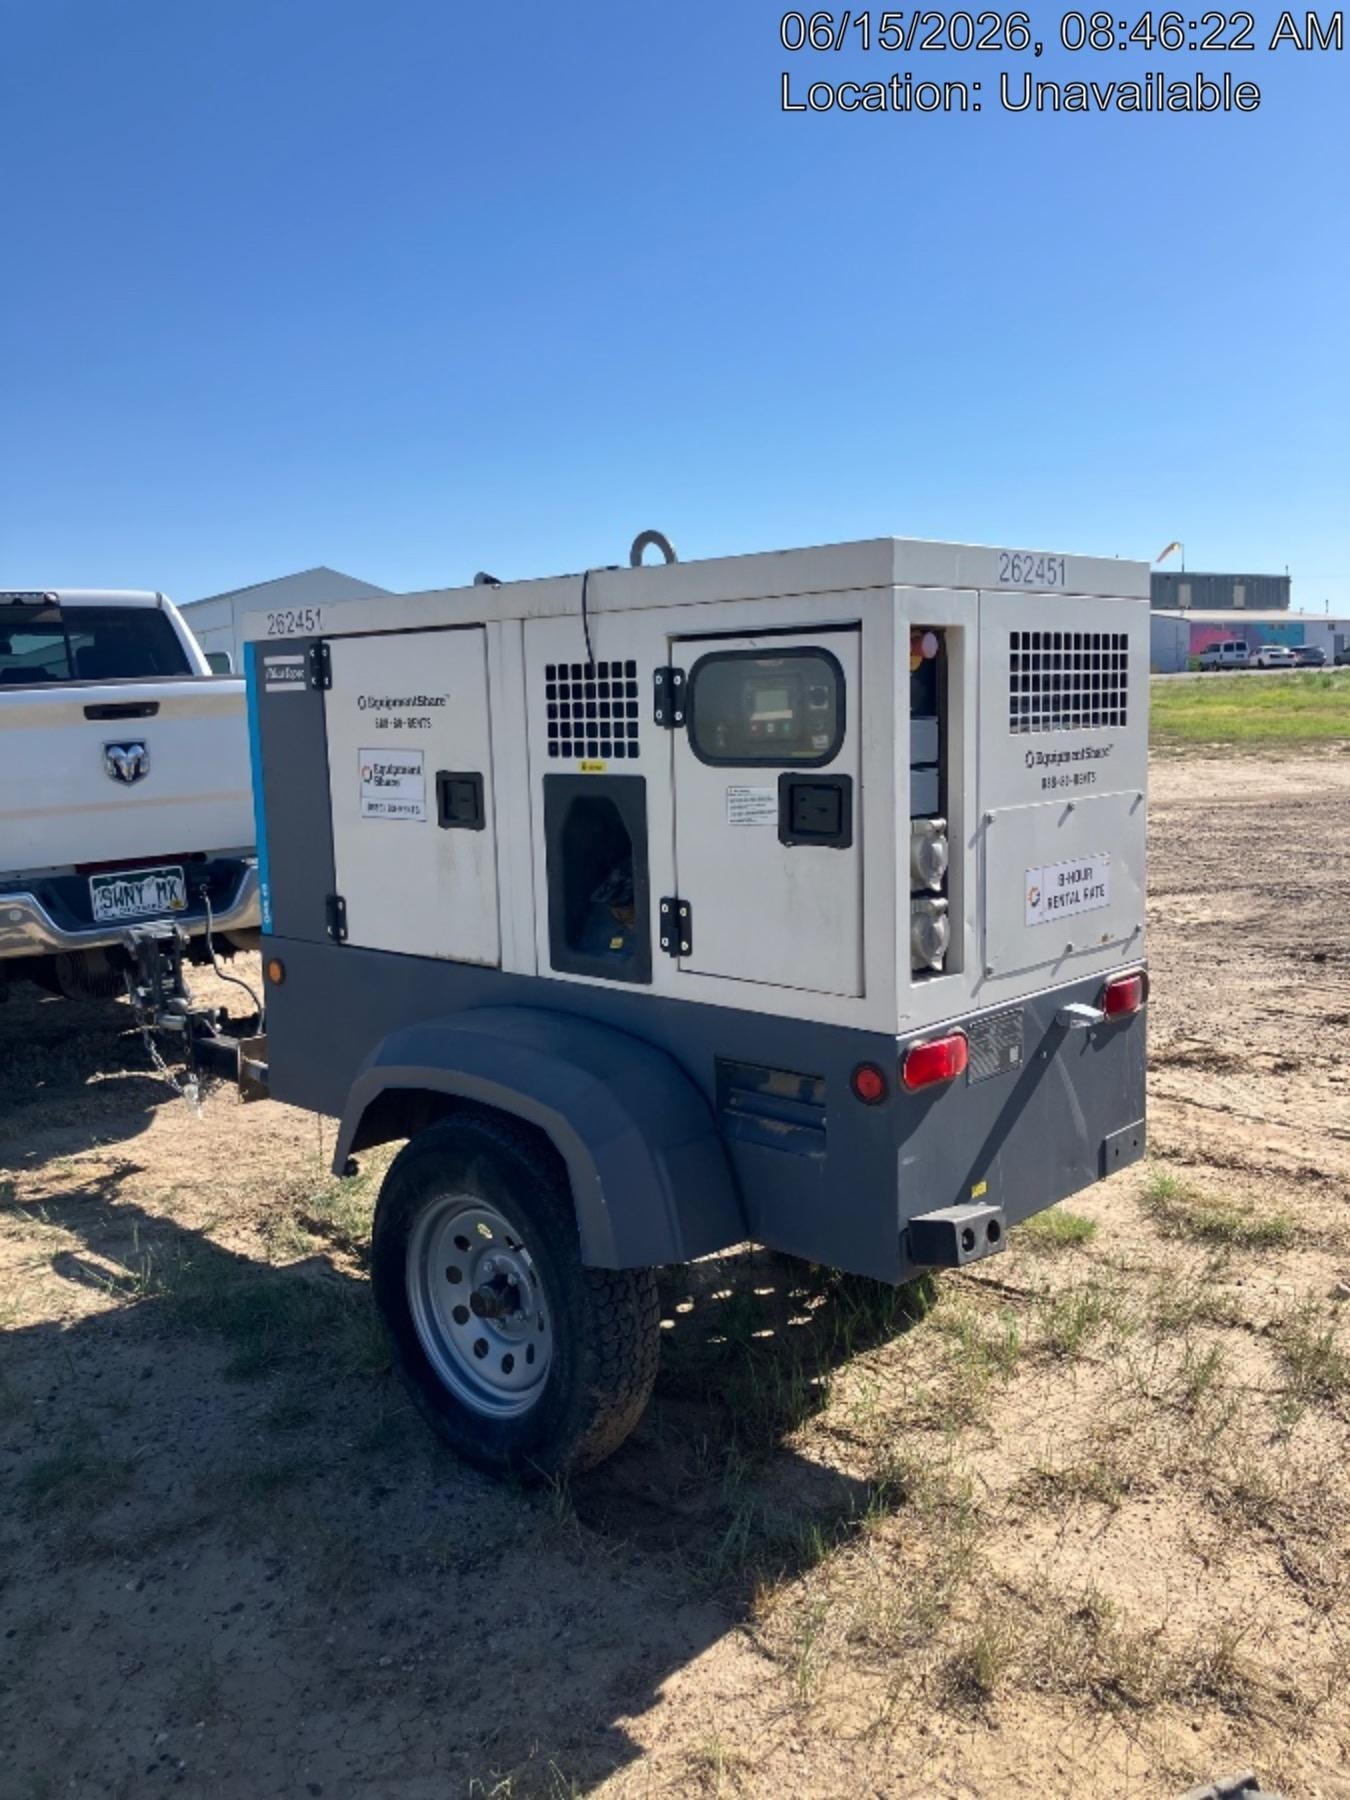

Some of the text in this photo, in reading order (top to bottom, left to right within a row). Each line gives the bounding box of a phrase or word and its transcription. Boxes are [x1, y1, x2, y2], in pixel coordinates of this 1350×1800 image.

[999, 552, 1066, 586] 262451
[267, 608, 323, 635] 262451
[1048, 889, 1080, 909] RENTAL
